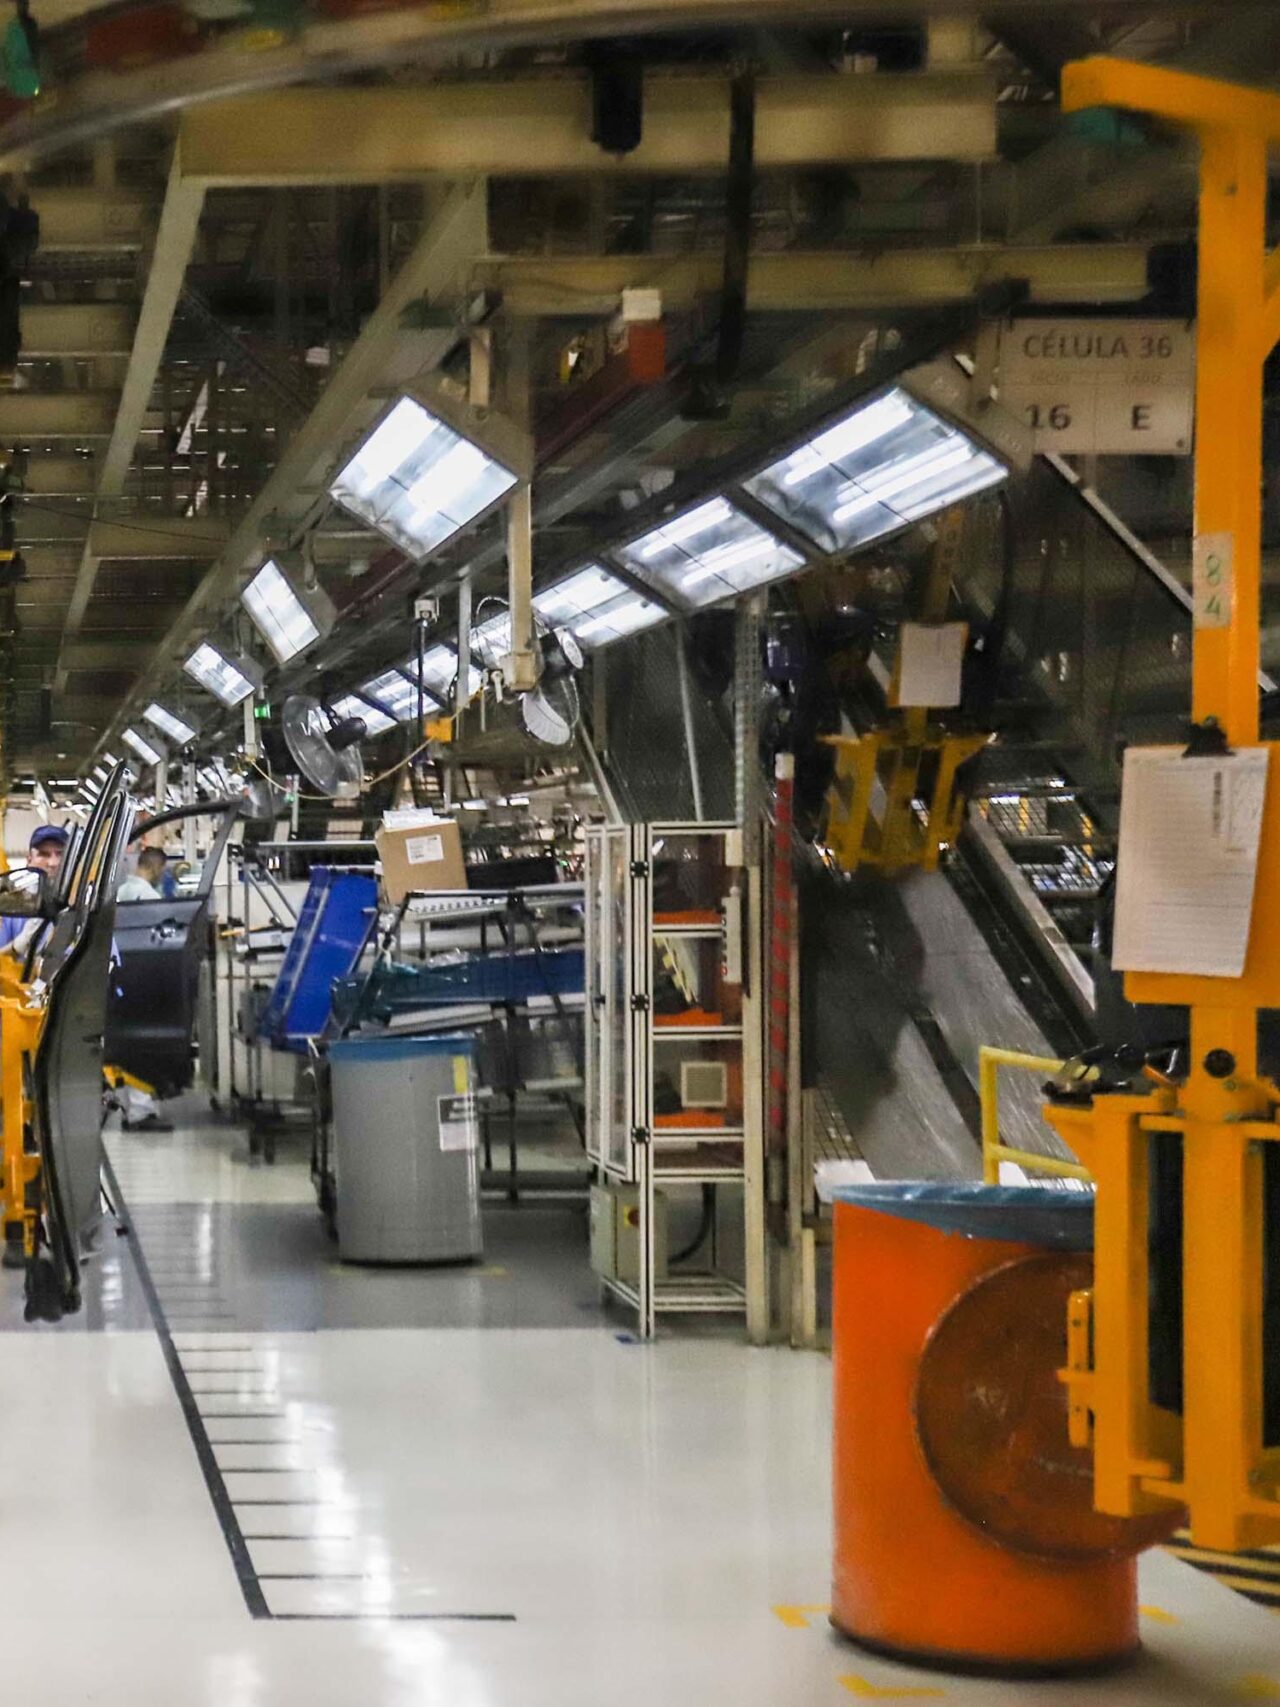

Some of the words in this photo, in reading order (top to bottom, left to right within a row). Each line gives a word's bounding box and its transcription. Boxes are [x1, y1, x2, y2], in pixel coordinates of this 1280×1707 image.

[1023, 328, 1129, 359] CÉLULA
[1138, 335, 1173, 359] 36
[1024, 403, 1072, 431] 16
[1130, 403, 1153, 431] E
